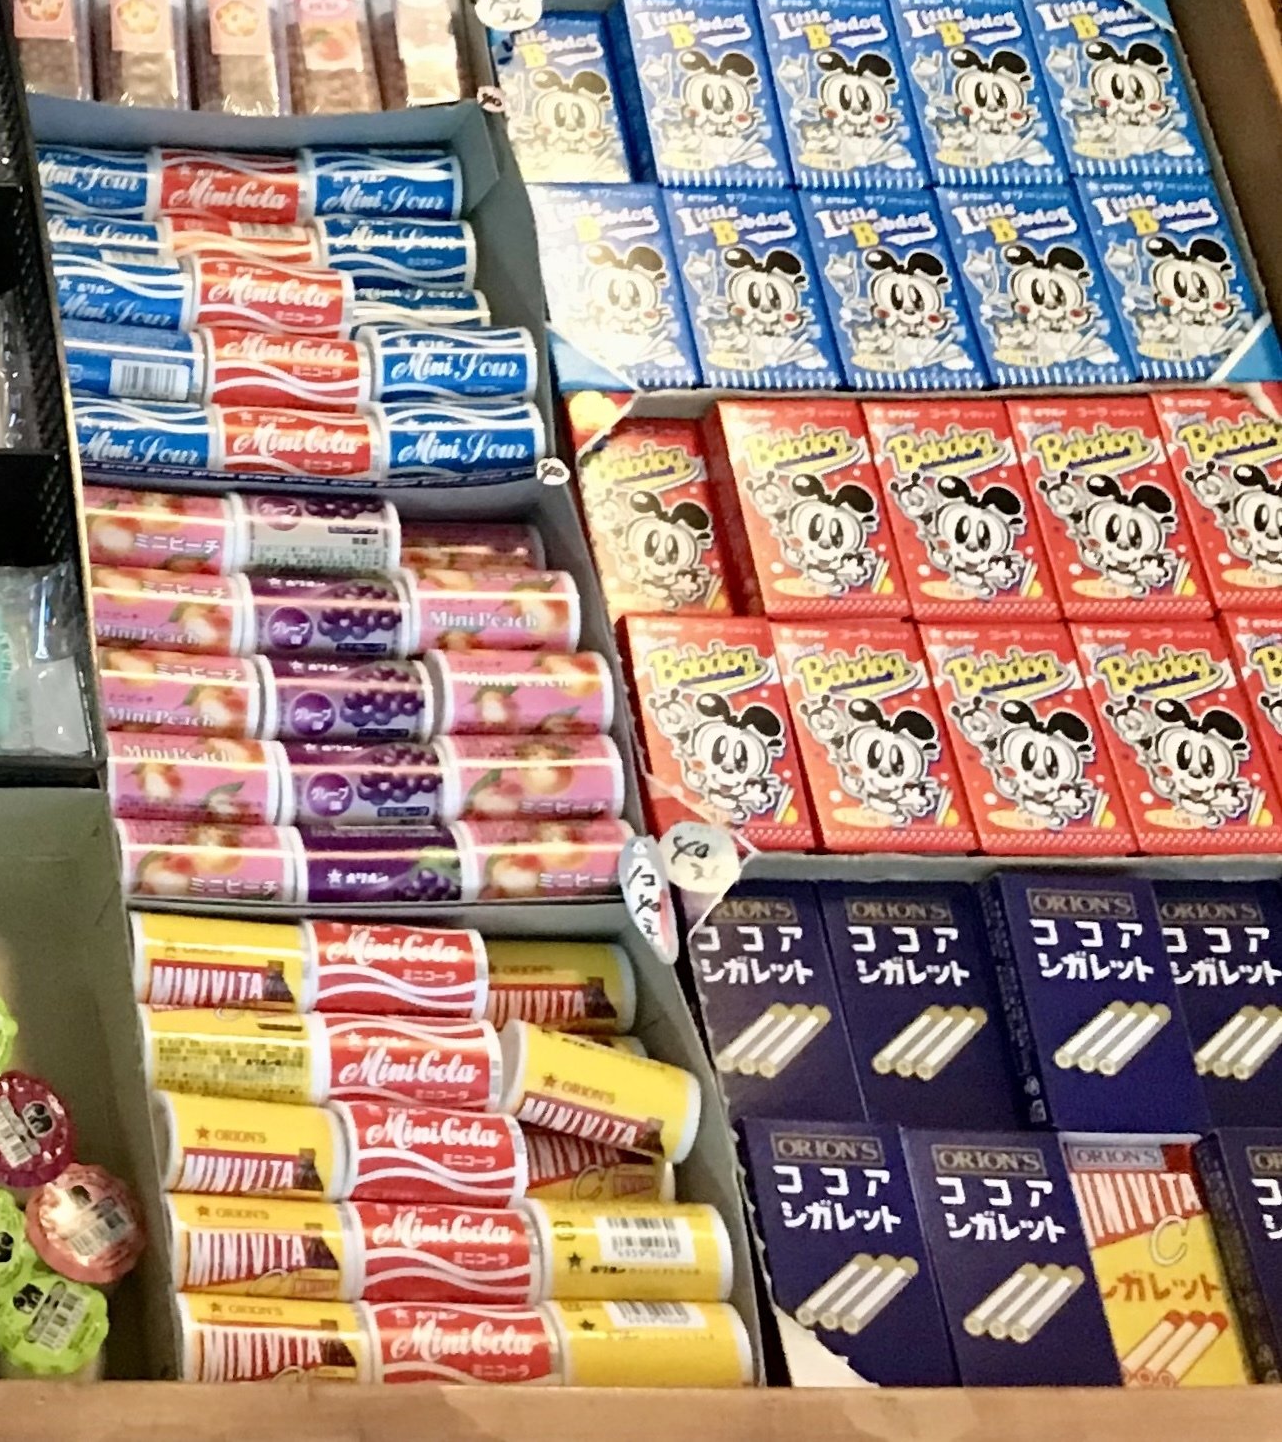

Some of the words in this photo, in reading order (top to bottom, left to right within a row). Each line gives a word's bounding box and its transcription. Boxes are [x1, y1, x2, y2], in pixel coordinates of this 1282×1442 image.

[744, 426, 849, 463] Bobdog
[888, 427, 993, 466] Bobdog
[1034, 426, 1142, 465] Bobdog
[133, 533, 220, 554] ミニピーチ
[650, 643, 759, 688] Bobdog
[795, 648, 908, 691] Bobdog
[946, 649, 1058, 692] Bobdog
[190, 876, 279, 896] ミニピーチ
[715, 899, 794, 917] RION'S
[696, 926, 803, 953] ココア
[847, 926, 959, 954] ココア
[1029, 918, 1143, 949] ココア
[1161, 926, 1270, 954] ココア
[701, 957, 814, 986] シガレット
[857, 958, 970, 987] シガレット
[1038, 950, 1155, 983] シガレット
[1171, 957, 1282, 986] シガレット
[152, 964, 264, 1005] MINIVITA
[185, 1154, 296, 1194] MINIVITA
[782, 1199, 902, 1234] シガレット
[1151, 1214, 1189, 1267] C
[191, 1230, 306, 1288] MINIVITA
